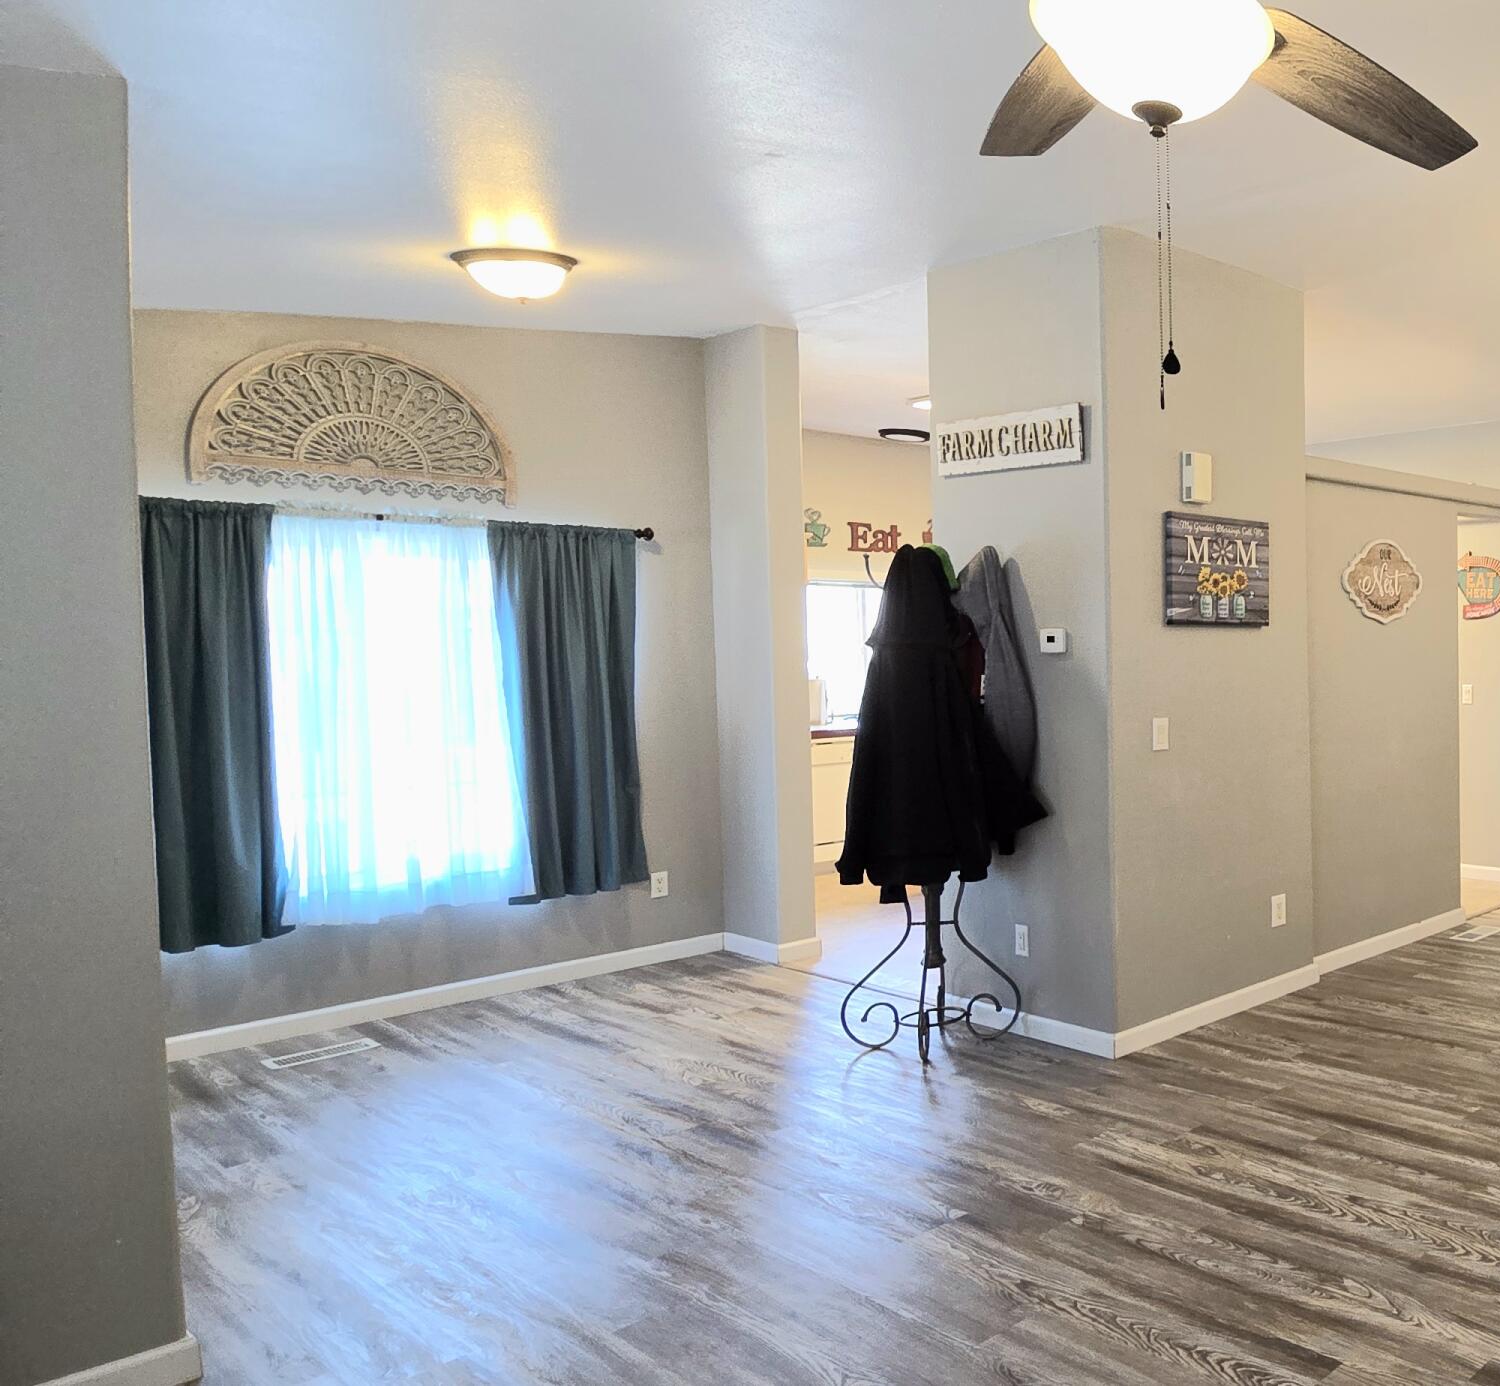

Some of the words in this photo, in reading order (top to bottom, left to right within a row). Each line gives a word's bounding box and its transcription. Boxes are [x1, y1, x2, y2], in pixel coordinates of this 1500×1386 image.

[938, 428, 995, 464] FARM
[998, 417, 1075, 457] CHARM
[847, 521, 901, 553] Eat
[1358, 562, 1408, 597] Nest
[1465, 571, 1497, 589] EAT
[1465, 587, 1494, 599] HERE
